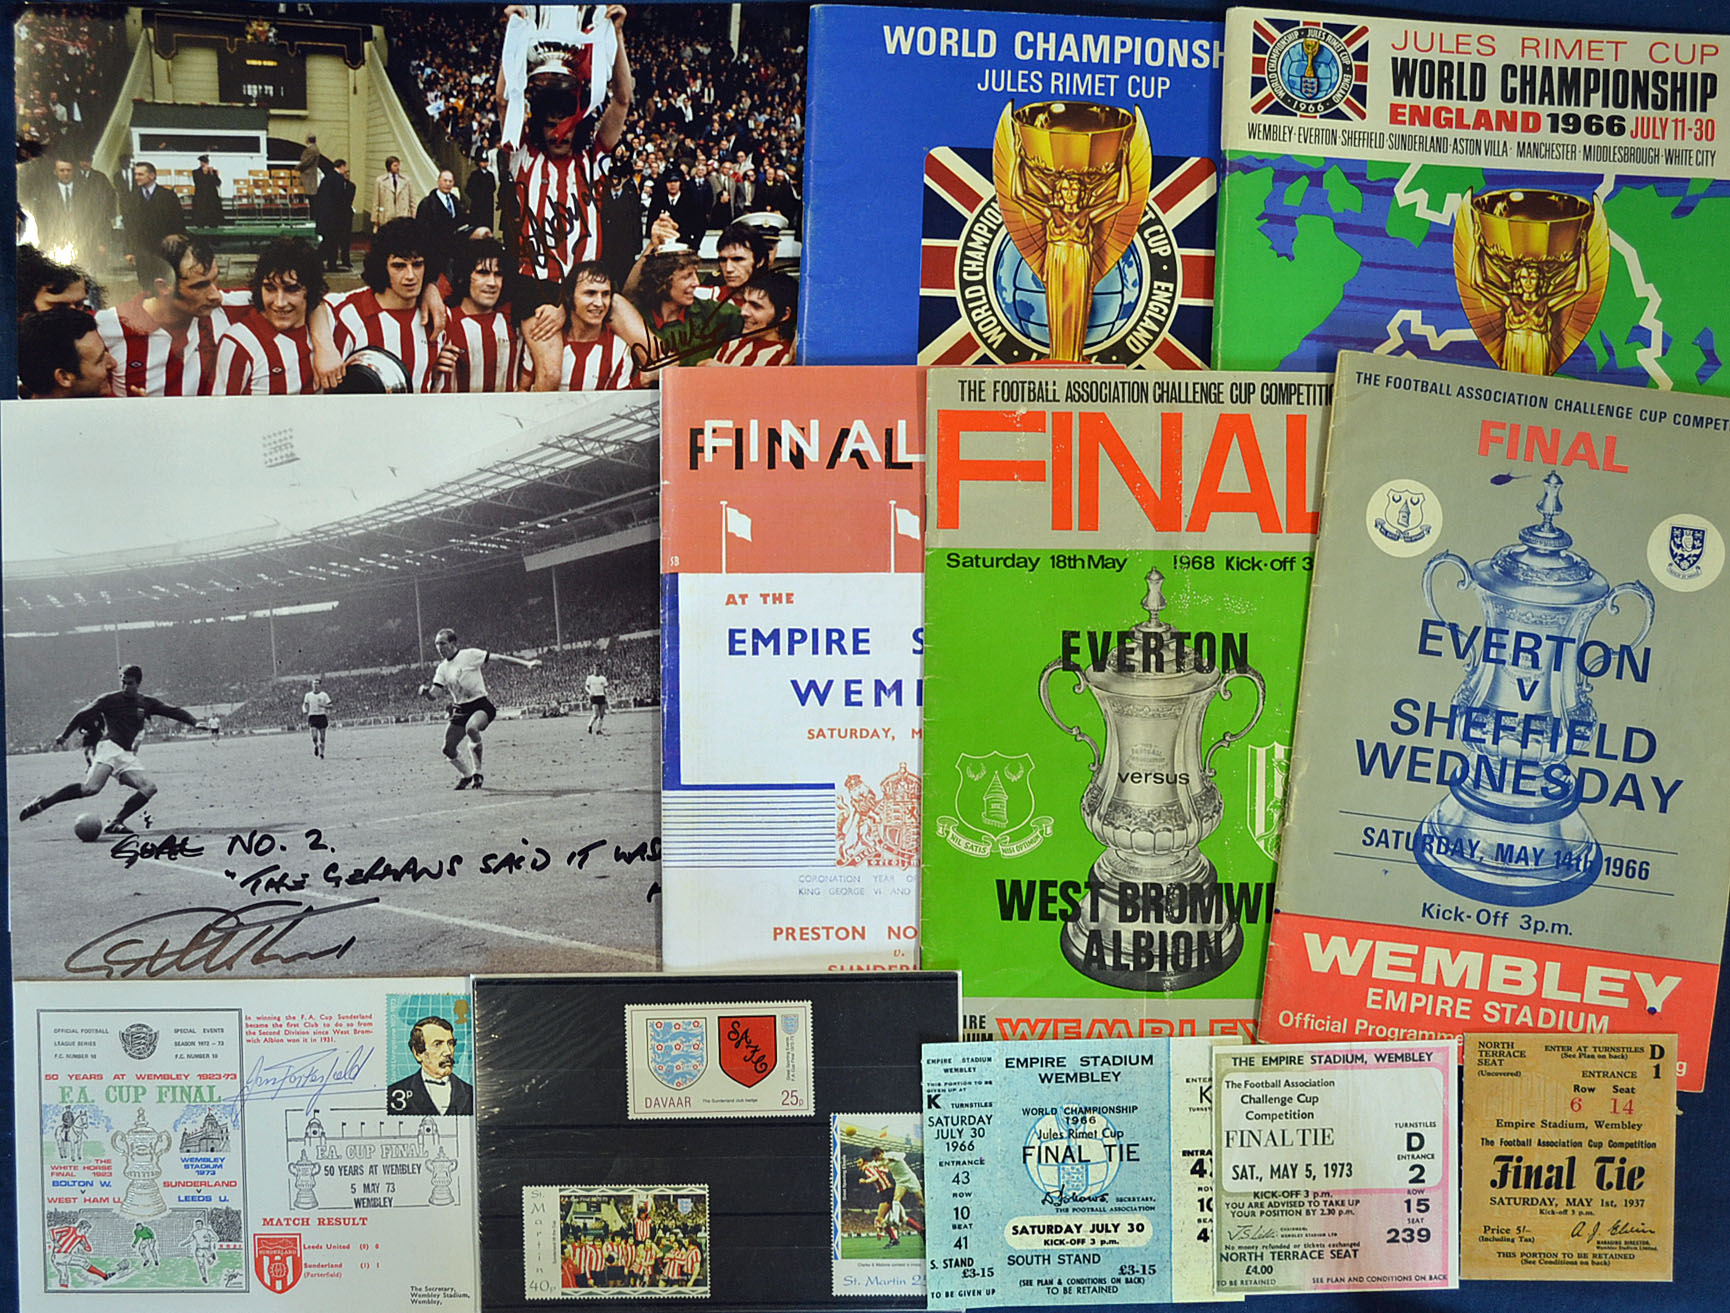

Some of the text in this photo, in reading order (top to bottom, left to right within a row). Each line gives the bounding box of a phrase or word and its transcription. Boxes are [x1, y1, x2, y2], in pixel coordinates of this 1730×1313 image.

[883, 25, 997, 58] WORLD
[1391, 30, 1719, 65] JULES RIMET CUP
[977, 69, 1171, 99] JULES RIMET CUP
[1391, 56, 1718, 113] WORLD CHAMPIONSHIP
[1389, 103, 1715, 142] ENGLAND 1966 JULY 11-30
[1248, 122, 1716, 168] WEMBLEY EVERTON SHEFFIELD SUNDERLAND ASTON VILLA MANCHESTER MIDDLESBROUGH WHITE CITY
[958, 379, 1256, 406] THE FOOTBALL ASSOCIATION CHALLENGE CUP
[1355, 371, 1667, 424] THE FOOTBALL ASSOCIATION CHALLENGE CUP
[694, 419, 926, 468] FINAL
[1477, 419, 1629, 474] FINAL
[936, 409, 1320, 534] FINAL
[946, 552, 1215, 572] Saturday 18th May 1968
[725, 593, 795, 606] AT THE
[728, 627, 871, 656] EMPIRE
[1061, 630, 1248, 673] EVERTON
[1418, 618, 1652, 684] EVERTON
[807, 727, 896, 741] SATURDAY,
[1390, 697, 1658, 764] SHEFFIELD
[1118, 771, 1190, 786] versus
[1355, 738, 1685, 815] WEDNESDAY
[1362, 826, 1651, 881] SATURDAY, MAY 14th 1966
[995, 879, 1103, 923] WEST
[1420, 901, 1573, 937] Kick-Off 3p.m.
[773, 926, 866, 941] PRESTON
[1084, 930, 1223, 973] ALBION
[1303, 932, 1683, 1014] WEMBLEY
[1366, 987, 1610, 1035] EMPIRE STADIUM
[1278, 1010, 1348, 1034] Official
[1478, 1041, 1515, 1050] NORTH
[1649, 1044, 1666, 1060] D
[1005, 1054, 1154, 1068] EMPIRE STADIUM
[1232, 1052, 1433, 1067] THE EMPIRE STADIUM, WEMBLEY
[1477, 1058, 1505, 1067] SEAT
[1478, 1050, 1527, 1059] TERRACE
[45, 1073, 59, 1081] 50
[67, 1073, 104, 1081] YEARS
[113, 1073, 126, 1081] AT
[135, 1073, 191, 1081] WEMBLEY
[1038, 1071, 1122, 1084] WEMBLEY
[1652, 1064, 1662, 1079] 1
[1225, 1078, 1335, 1089] The Football Association
[59, 1084, 222, 1105] F.A. CUP FINAL
[644, 1096, 692, 1109] DAVAAR
[1240, 1093, 1319, 1106] Challenge Cup
[1022, 1105, 1138, 1116] WORLD CHAMPIONSHIP
[1570, 1096, 1583, 1112] 6
[1610, 1097, 1635, 1115] 14
[928, 1114, 993, 1127] SATURDAY
[1065, 1116, 1097, 1125] 1966
[1245, 1109, 1315, 1122] Competition
[1496, 1119, 1643, 1131] Empire Stadium, Wembley
[934, 1127, 986, 1140] JULY 30
[1037, 1127, 1124, 1141] Jules Rimet Cup
[1225, 1127, 1335, 1148] FINAL TIE
[1406, 1132, 1425, 1152] D
[1022, 1143, 1141, 1164] FINAL TIE
[1231, 1161, 1353, 1182] SAT., MAY 5, 1973
[1408, 1164, 1426, 1184] 2
[1490, 1155, 1646, 1191] Final Tie
[52, 1180, 112, 1188] BOLTON W.
[163, 1180, 237, 1188] SUNDERLAND
[353, 1196, 394, 1209] WEMBLEY
[1404, 1198, 1431, 1213] 15
[1490, 1197, 1559, 1208] SATURDAY,
[1565, 1197, 1594, 1207] MAY
[1623, 1199, 1646, 1208] 1937
[262, 1217, 368, 1226] MATCH RESULT
[1011, 1222, 1145, 1236] SATURDAY JULY 30
[1386, 1228, 1432, 1244] 239
[1007, 1253, 1101, 1266] SOUTH STAND
[1219, 1249, 1360, 1263] NORTH TERRACE SEAT
[1118, 1264, 1157, 1276] £3-15
[1245, 1265, 1274, 1275] £4.00
